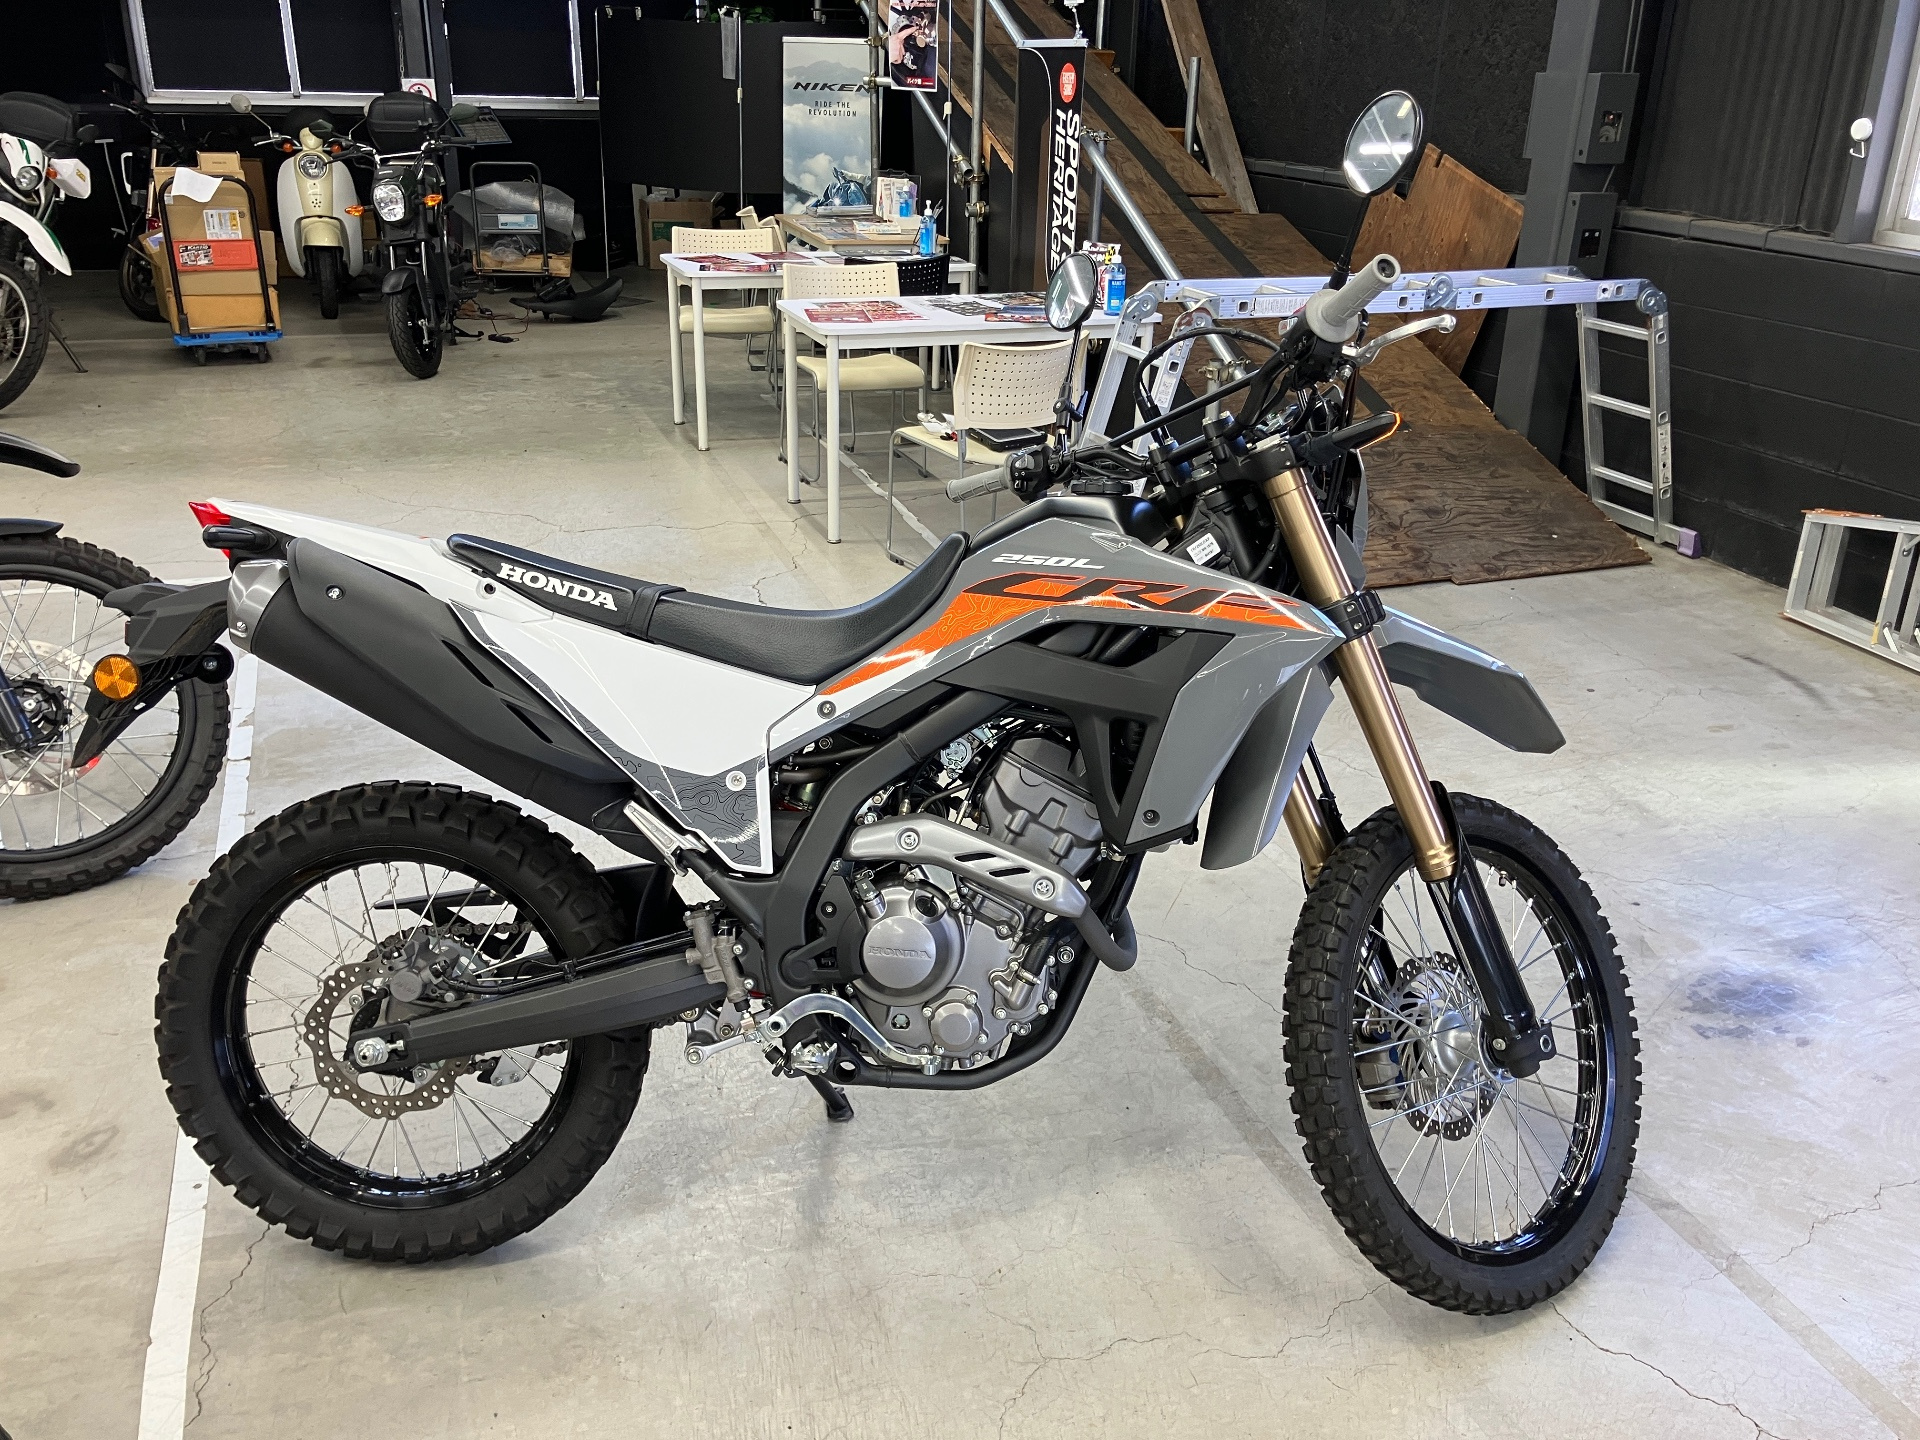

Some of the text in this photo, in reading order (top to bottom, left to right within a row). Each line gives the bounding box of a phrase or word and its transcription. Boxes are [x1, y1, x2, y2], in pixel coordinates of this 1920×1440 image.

[793, 82, 870, 94] NIKEN
[808, 109, 857, 117] REVOLUTION
[837, 101, 850, 109] THE
[1050, 108, 1067, 272] HERITAGE
[1060, 109, 1080, 262] SPORT
[992, 553, 1105, 569] 250L
[496, 562, 618, 612] HONDA
[868, 945, 932, 961] HONDA
